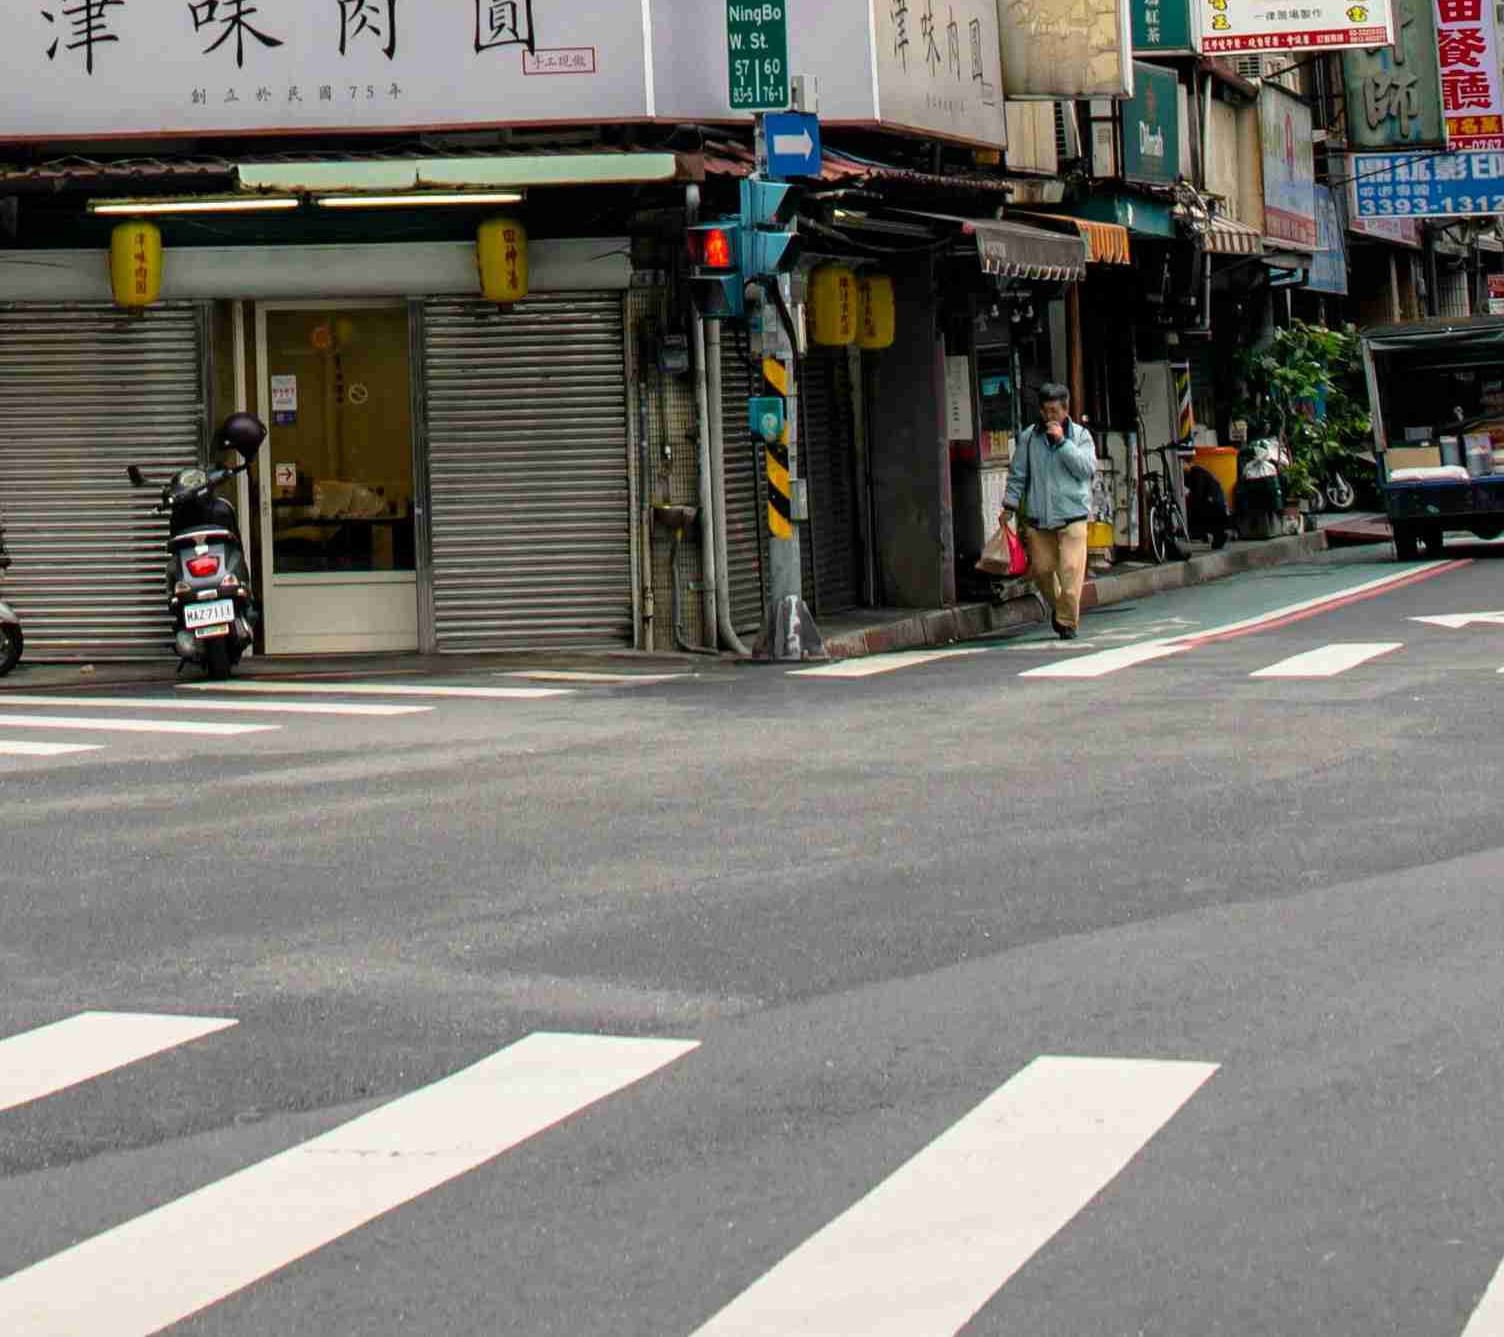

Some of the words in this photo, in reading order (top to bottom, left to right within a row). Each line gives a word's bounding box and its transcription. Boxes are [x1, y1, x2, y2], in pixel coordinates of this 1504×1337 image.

[728, 4, 782, 26] NingBo
[729, 33, 747, 50] W.
[749, 32, 769, 50] St.
[734, 58, 750, 76] 57
[763, 58, 781, 75] 60
[732, 86, 754, 104] 83-5
[763, 84, 784, 103] 76-1
